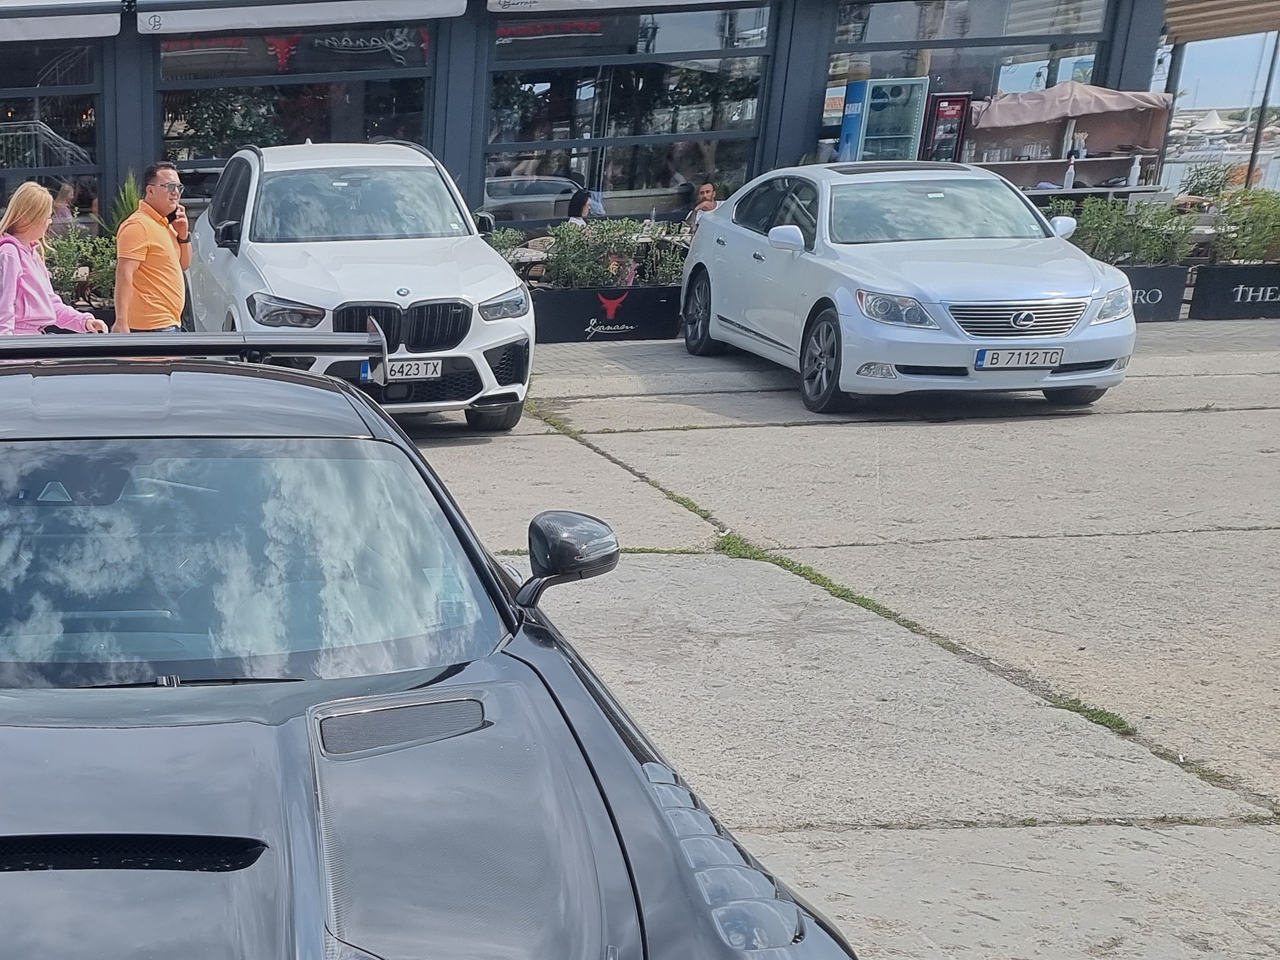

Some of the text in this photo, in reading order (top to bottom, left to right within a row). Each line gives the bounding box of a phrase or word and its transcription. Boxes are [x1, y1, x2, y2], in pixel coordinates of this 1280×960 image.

[990, 351, 1059, 366] B 7112 TC
[389, 361, 440, 377] 6423 TX
